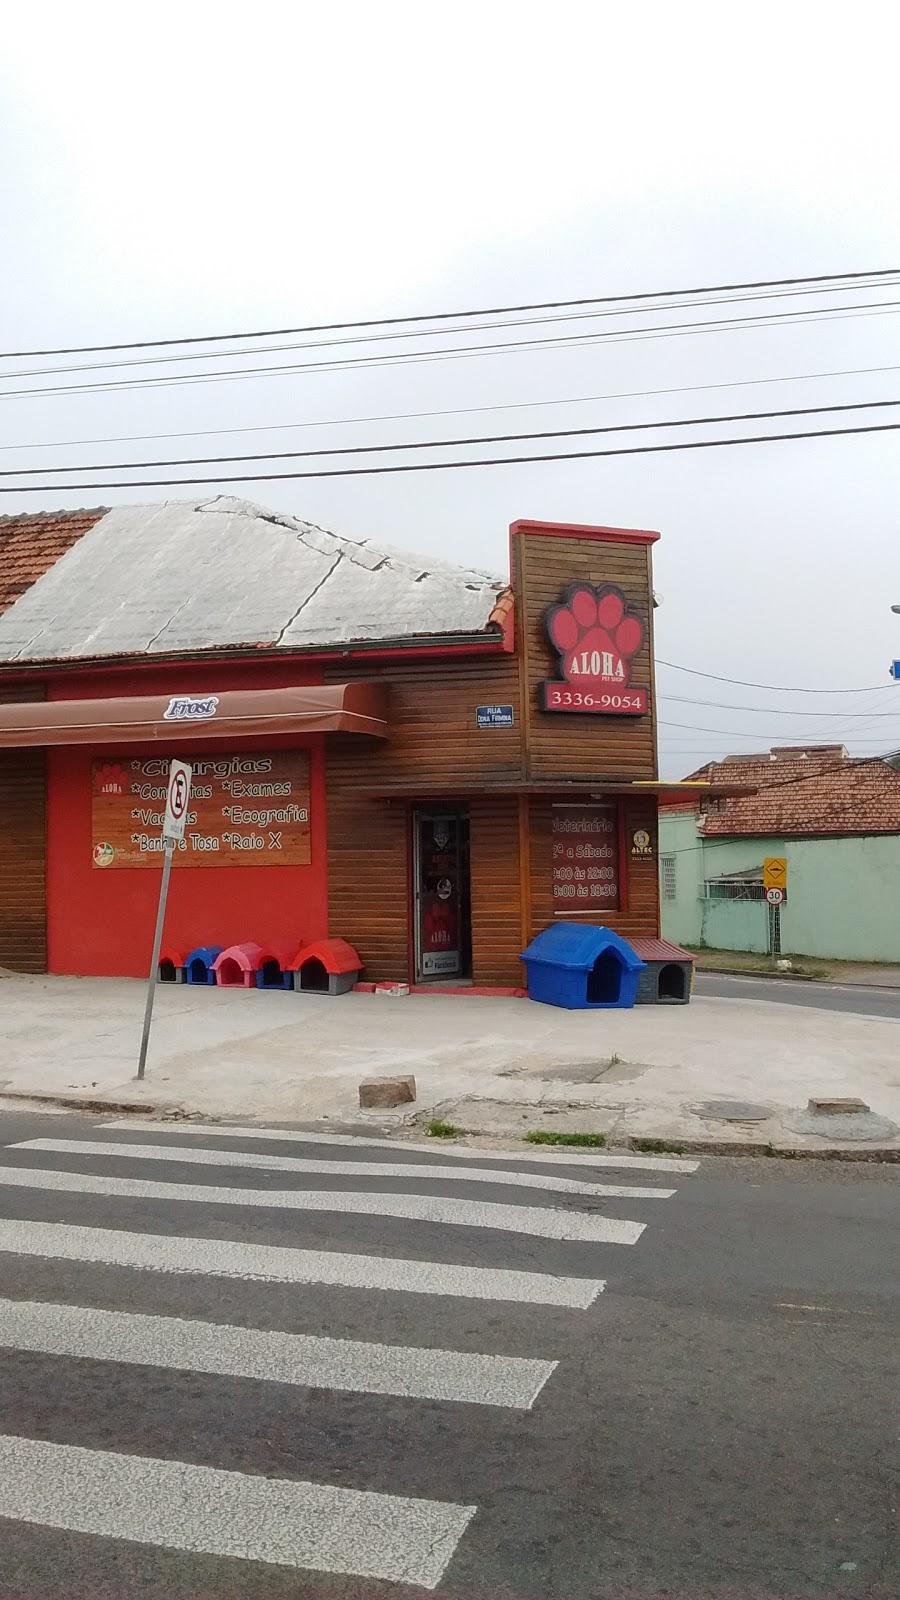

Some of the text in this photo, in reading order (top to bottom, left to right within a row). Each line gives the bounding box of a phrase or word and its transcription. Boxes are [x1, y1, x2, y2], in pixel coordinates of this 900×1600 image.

[569, 651, 625, 678] ALOHA
[166, 698, 217, 718] Frost
[551, 691, 642, 709] 3336-9054
[178, 837, 188, 852] e
[190, 834, 219, 851] Tosa
[268, 831, 282, 850] X
[769, 891, 781, 900] 30
